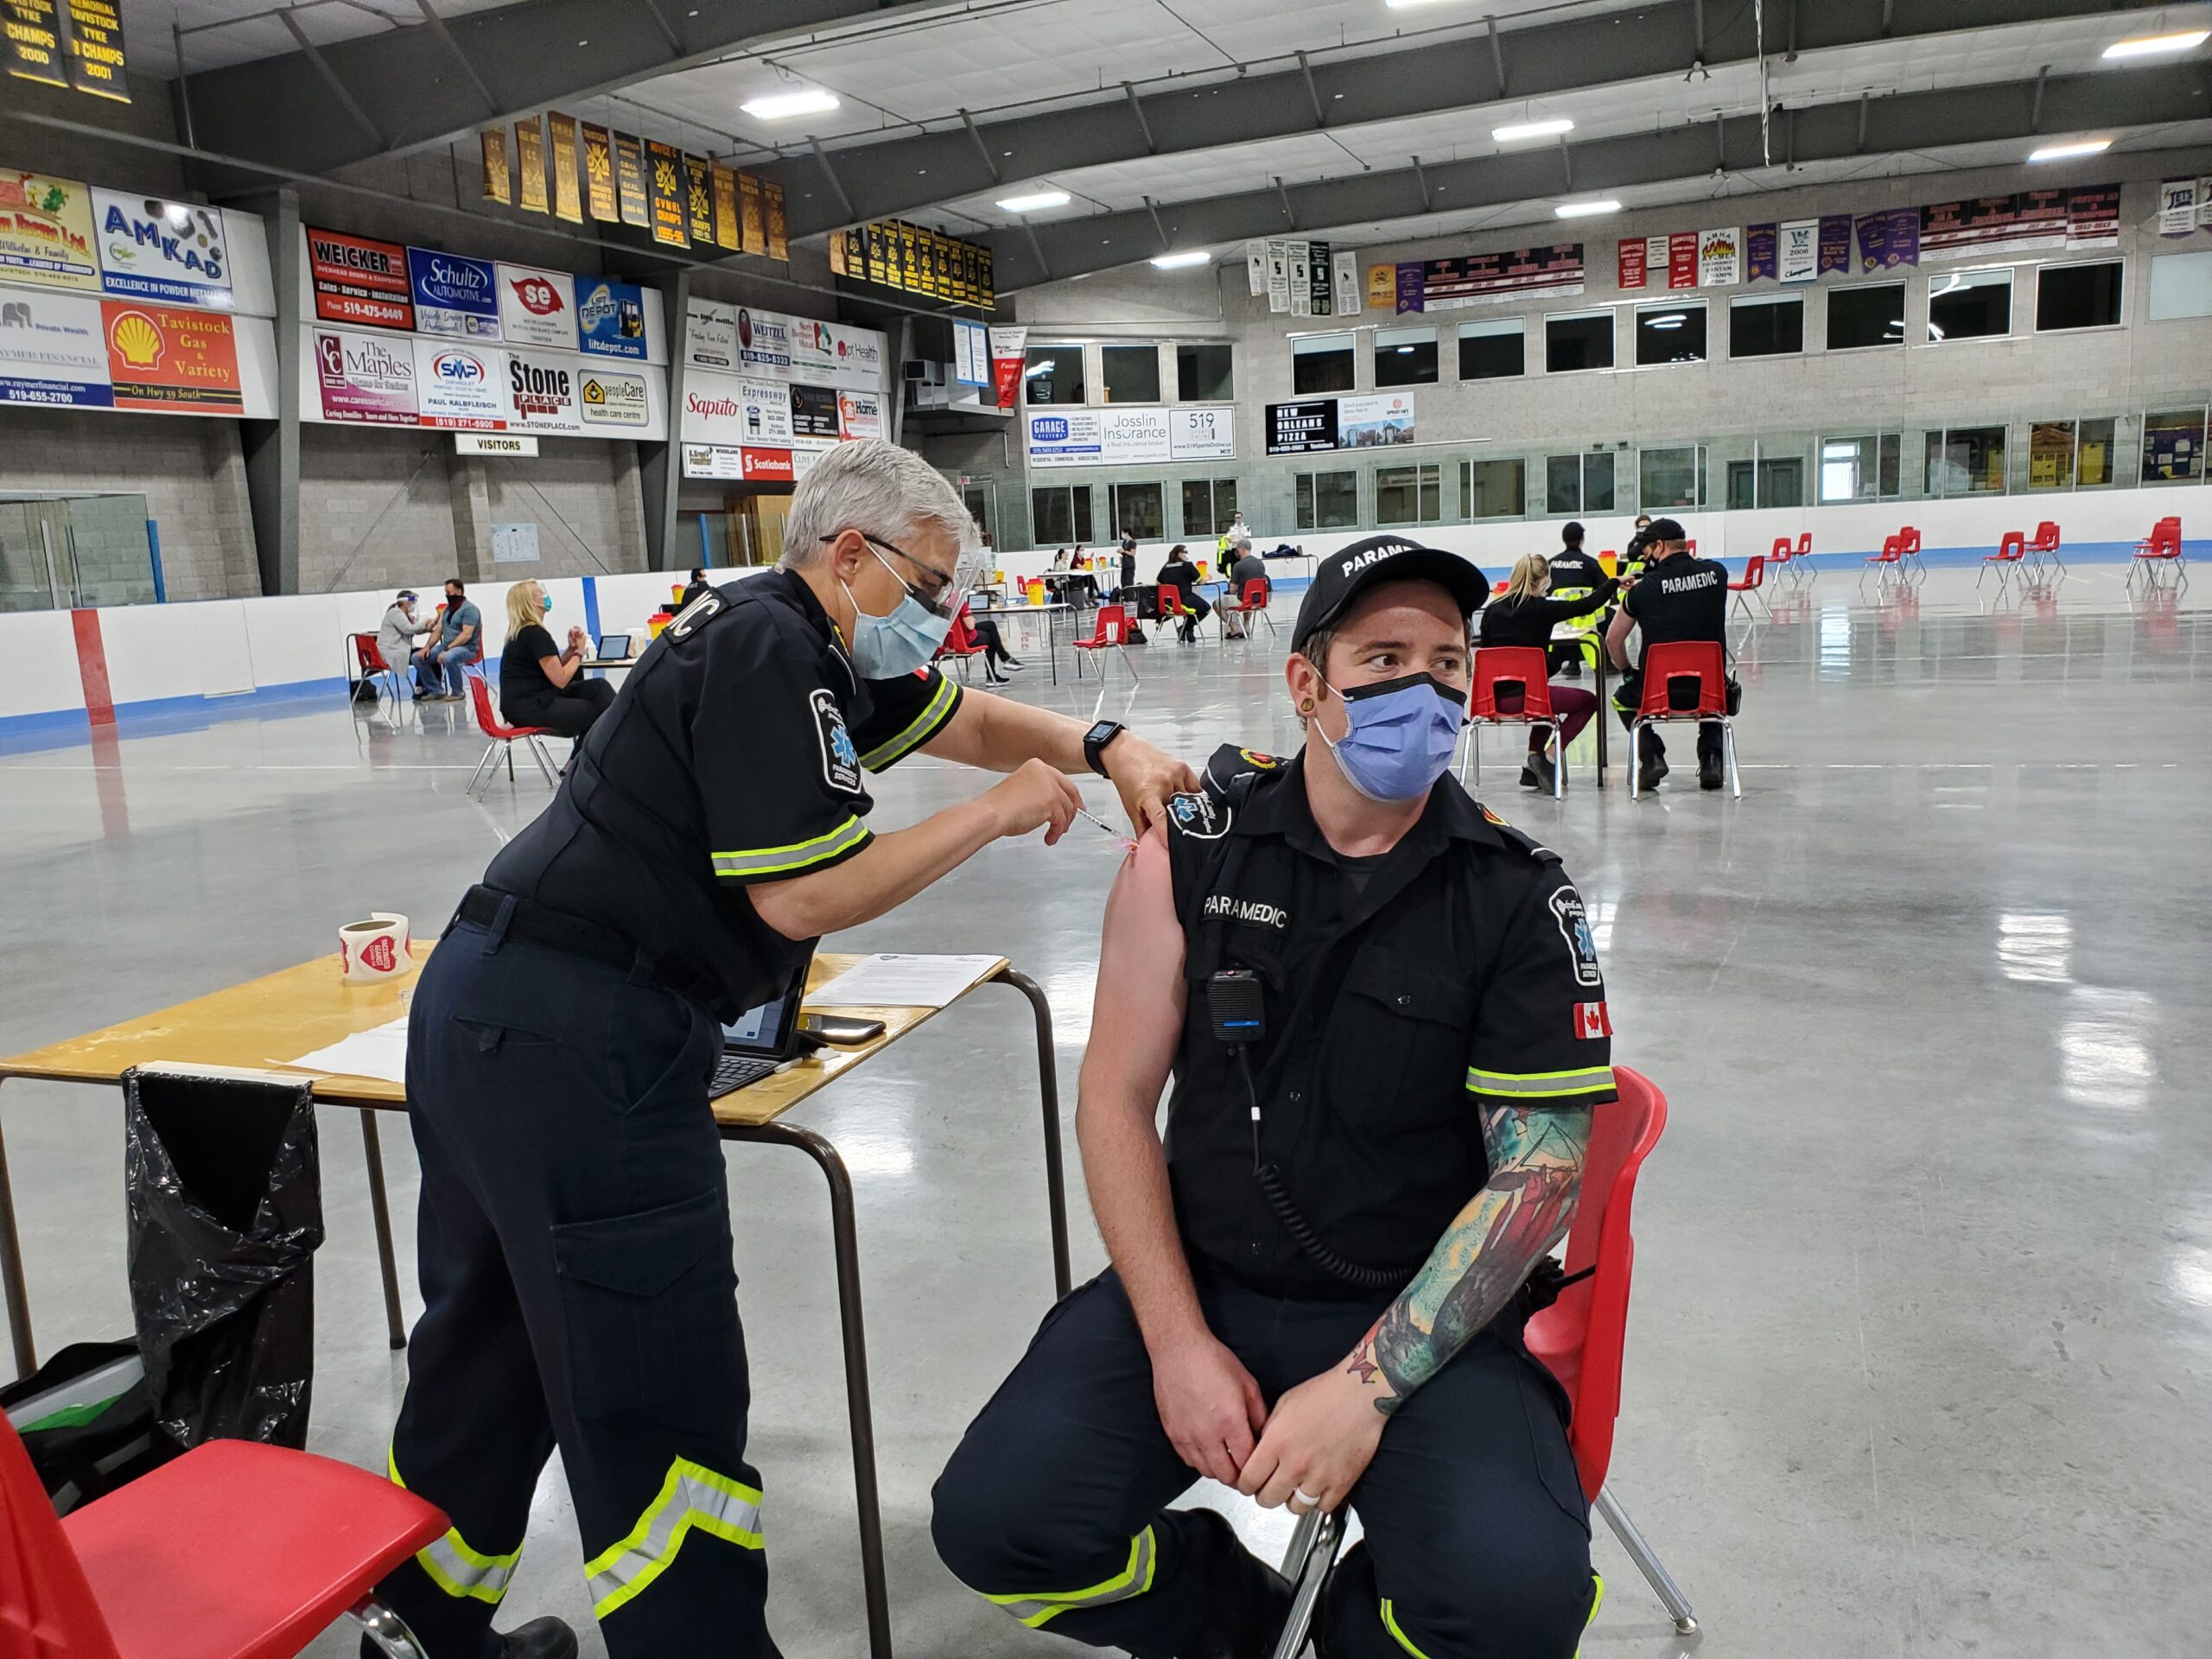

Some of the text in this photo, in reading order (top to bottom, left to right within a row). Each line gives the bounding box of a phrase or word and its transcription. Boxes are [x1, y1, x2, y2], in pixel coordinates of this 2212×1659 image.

[14, 6, 41, 23] TYKE
[70, 7, 119, 31] TAVISTOCK
[6, 22, 55, 48] CHAMPS
[82, 26, 107, 43] TYKE
[19, 46, 49, 65] 2000
[82, 41, 124, 66] CHAMPS
[86, 62, 111, 80] 2001
[2168, 189, 2192, 210] JETS
[657, 210, 682, 226] CHAMPS
[60, 226, 92, 259] Ltd.
[105, 205, 222, 279] AMKAD
[1620, 244, 1644, 253] HANOVER
[1671, 236, 1696, 245] HANOVER
[44, 246, 69, 261] Family
[313, 239, 392, 274] WEICKER
[429, 258, 480, 289] Schultz
[105, 276, 149, 292] EXCELLENCE
[150, 283, 158, 293] IN
[160, 283, 188, 297] POWDER
[319, 281, 338, 293] Sales
[341, 285, 368, 297] Service
[433, 284, 480, 302] AUTOMOTIVE
[524, 283, 551, 306] se
[344, 301, 404, 321] 519-475-0449
[582, 303, 617, 319] DEPOT
[157, 313, 231, 335] Tavistock
[753, 322, 787, 339] WEITZEL
[180, 334, 207, 350] Gas
[362, 340, 387, 358] The
[588, 338, 640, 355] liftdepot.com
[847, 343, 879, 360] pt Health
[175, 359, 231, 383] Variety
[346, 350, 412, 380] Maples
[441, 363, 478, 380] SMP
[510, 359, 570, 397] Stone
[9, 389, 73, 404] 519-655-2700
[131, 385, 201, 401] On Hwy 59 South
[605, 382, 645, 399] peopleCare
[742, 385, 787, 404] Expressway
[449, 399, 497, 409] KALBFLEISCH
[521, 395, 570, 406] PLACE
[686, 392, 740, 421] Saputo
[855, 401, 878, 416] Home
[591, 408, 641, 420] health care centre
[1114, 413, 1156, 428] Josslin
[1190, 413, 1215, 429] 519
[1276, 408, 1299, 418] NEW
[509, 421, 581, 431] www.STONEPLACE.com
[1033, 421, 1065, 434] GARAGE
[1276, 418, 1322, 430] ORLEANS
[1103, 427, 1166, 440] Insurance
[1277, 432, 1307, 442] PIZZA
[476, 439, 521, 451] VISITORS
[754, 459, 791, 471] Scotiabank
[1550, 560, 1583, 569] PARAMEDIC
[1662, 570, 1718, 595] PARAMEDIC
[832, 764, 858, 780] PARAMEDIC
[834, 772, 856, 786] SERVICES
[1204, 895, 1288, 929] PARAMEDIC
[374, 944, 384, 966] AGAINST
[380, 938, 391, 969] VACCINATED
